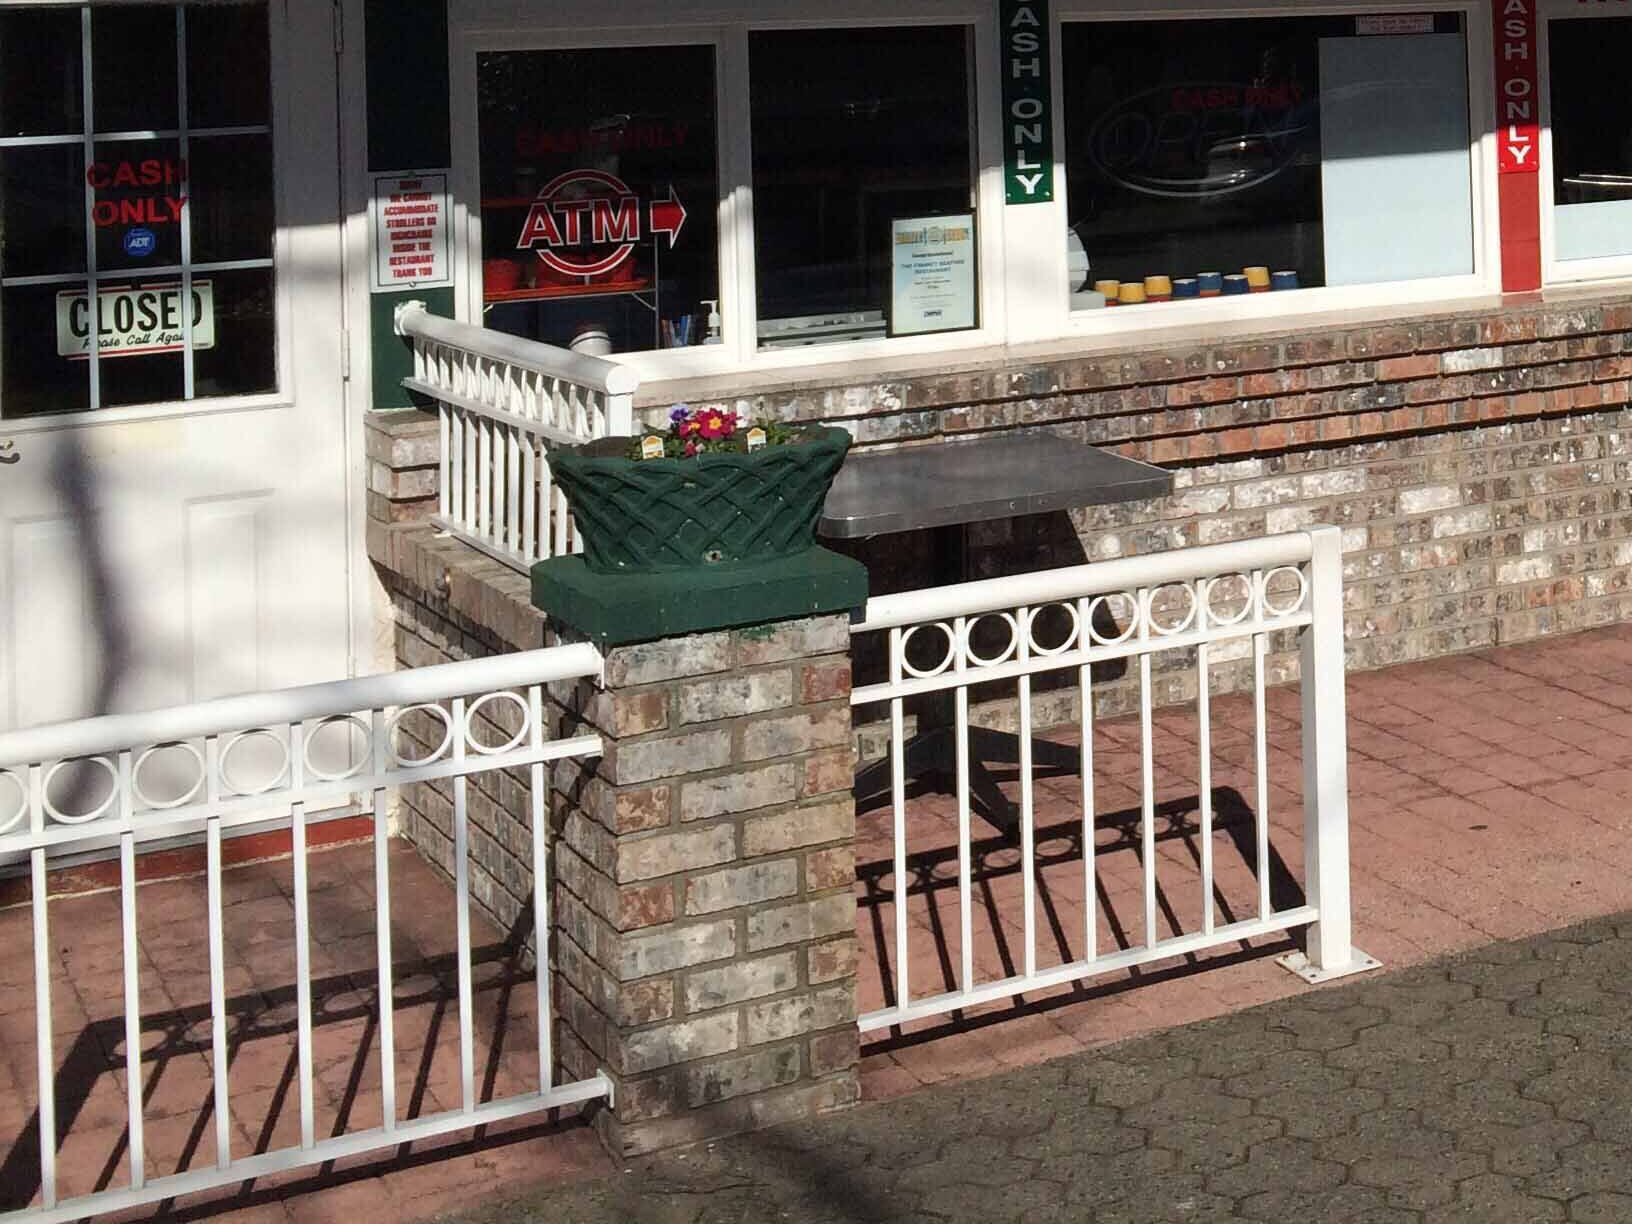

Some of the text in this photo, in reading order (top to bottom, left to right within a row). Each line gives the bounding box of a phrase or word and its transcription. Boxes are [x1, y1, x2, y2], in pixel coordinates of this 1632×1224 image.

[1502, 77, 1532, 165] ONLY
[1011, 97, 1044, 195] ONLY
[87, 160, 188, 189] CASH
[92, 196, 189, 227] ONLY
[515, 196, 641, 250] ATM
[129, 236, 151, 248] ADT
[69, 290, 202, 338] CLOSED
[127, 332, 151, 346] Call
